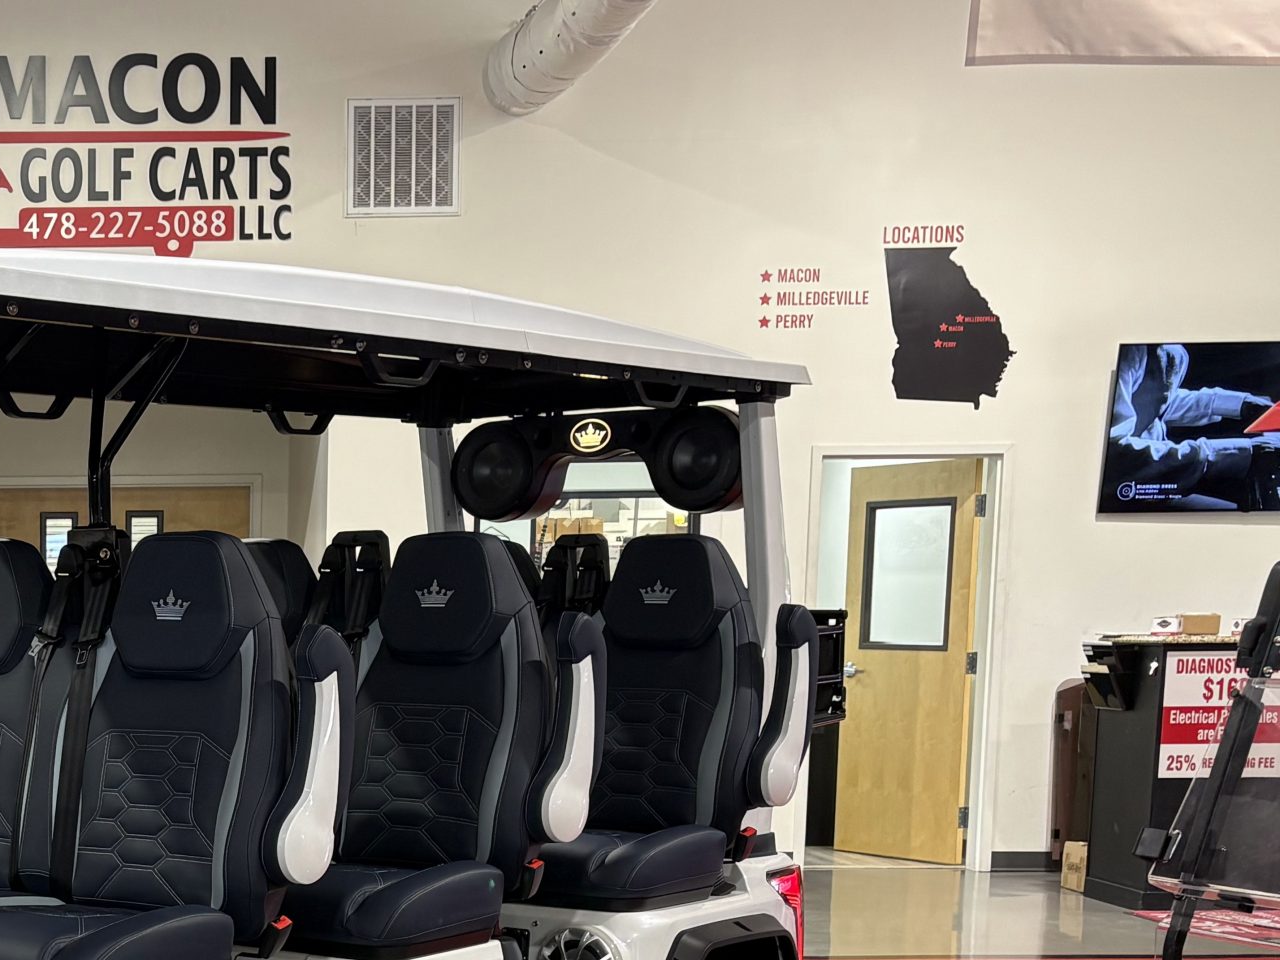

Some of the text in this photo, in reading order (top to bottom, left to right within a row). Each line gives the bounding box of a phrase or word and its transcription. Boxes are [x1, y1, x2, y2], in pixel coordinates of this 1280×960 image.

[20, 146, 292, 203] GOLF CARTS
[23, 209, 227, 241] 478-227-5088
[239, 204, 292, 241] LLC
[883, 225, 965, 244] LOCATIONS
[777, 268, 820, 283] MACON
[776, 290, 869, 306] MILLEDGEVILLE
[775, 314, 814, 329] PERRY
[1169, 709, 1218, 724] Electrical
[1197, 728, 1215, 740] are
[1166, 754, 1196, 771] 25%
[1258, 757, 1275, 769] FEE
